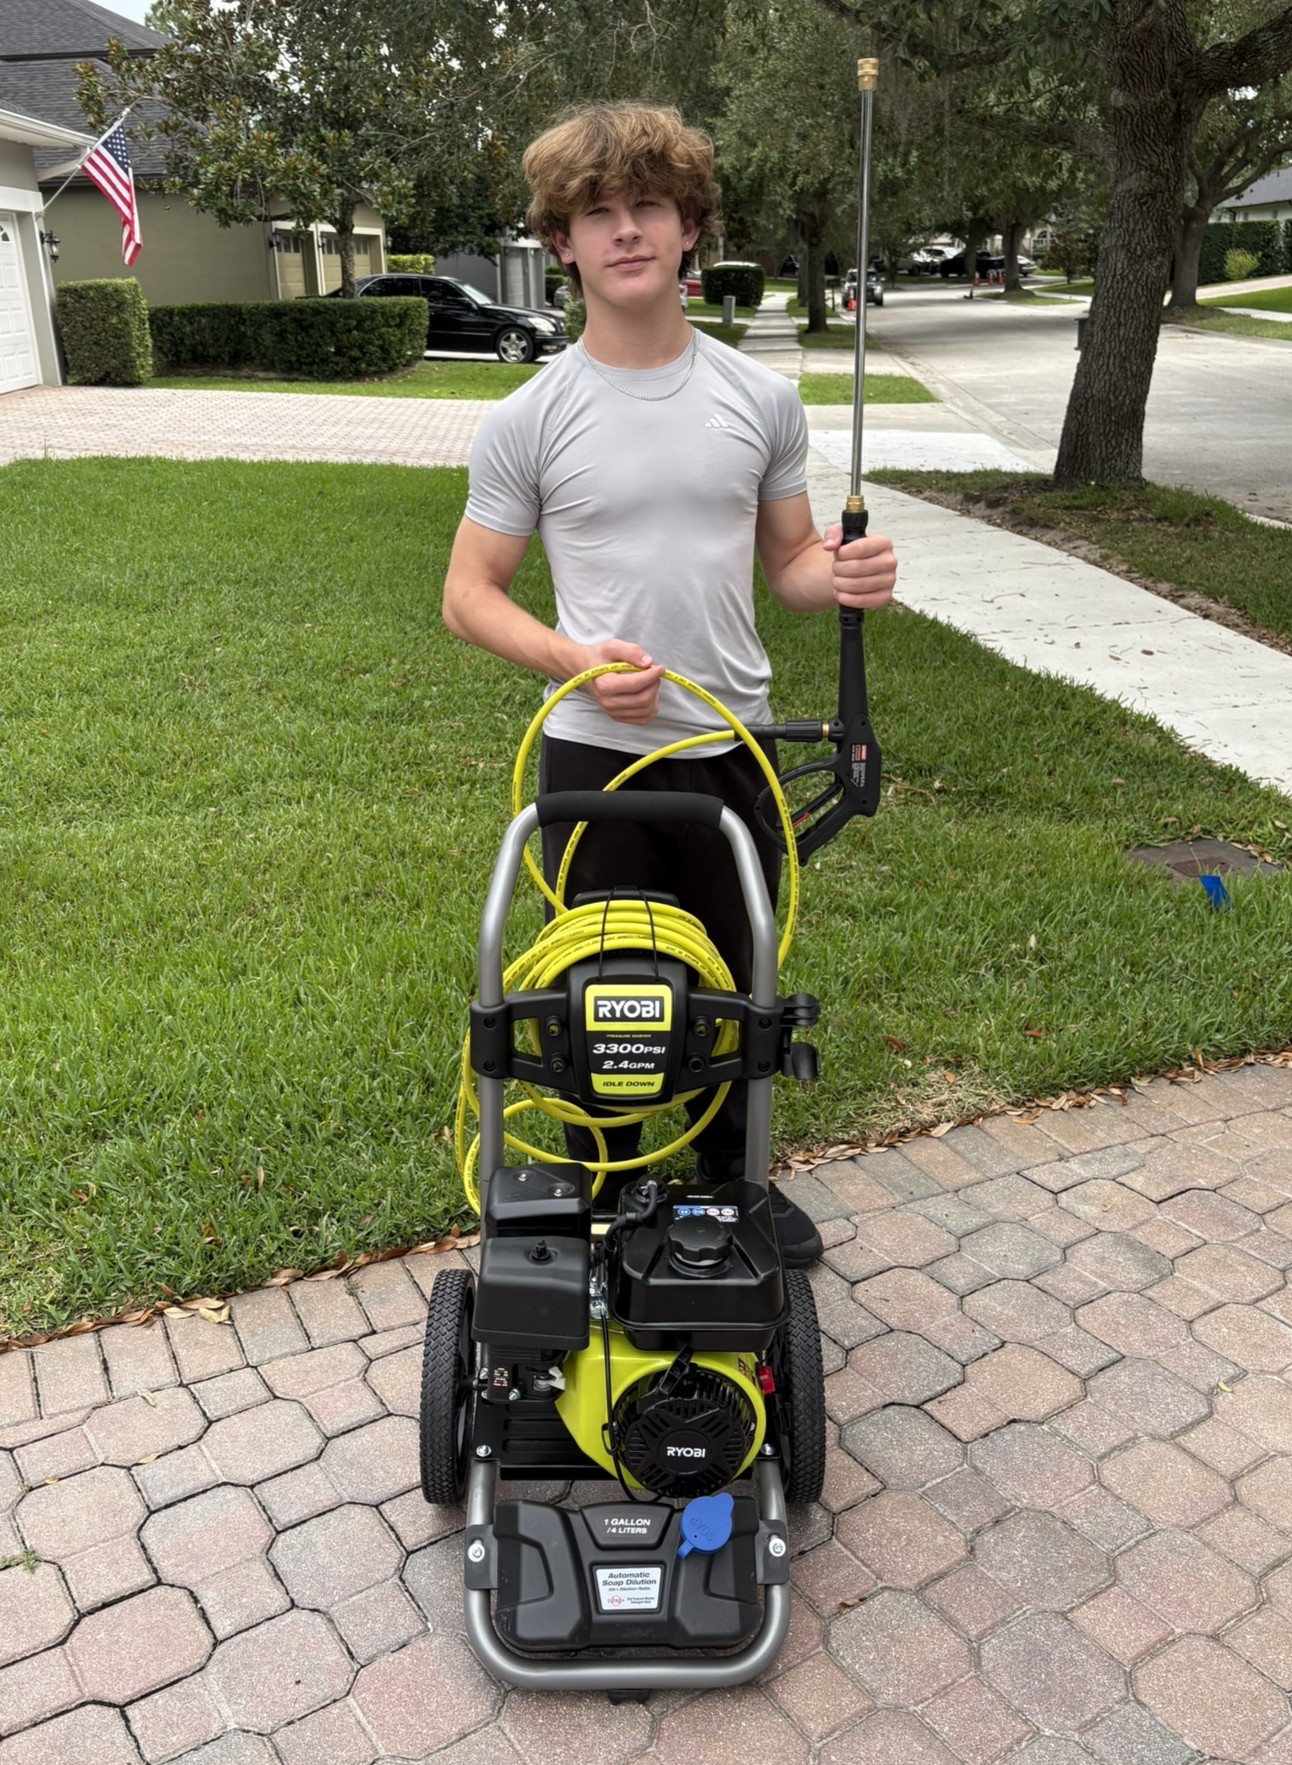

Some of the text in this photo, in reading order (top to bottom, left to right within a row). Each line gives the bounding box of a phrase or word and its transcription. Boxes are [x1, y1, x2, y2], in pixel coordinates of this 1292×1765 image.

[597, 1000, 660, 1018] RYOBI
[592, 1043, 666, 1054] 3300PSI
[602, 1060, 655, 1069] 2.4GPM
[666, 1446, 706, 1458] RYOBI
[604, 1518, 651, 1526] 1 GALLON
[608, 1571, 650, 1579] Automatic
[602, 1579, 624, 1587] Soap
